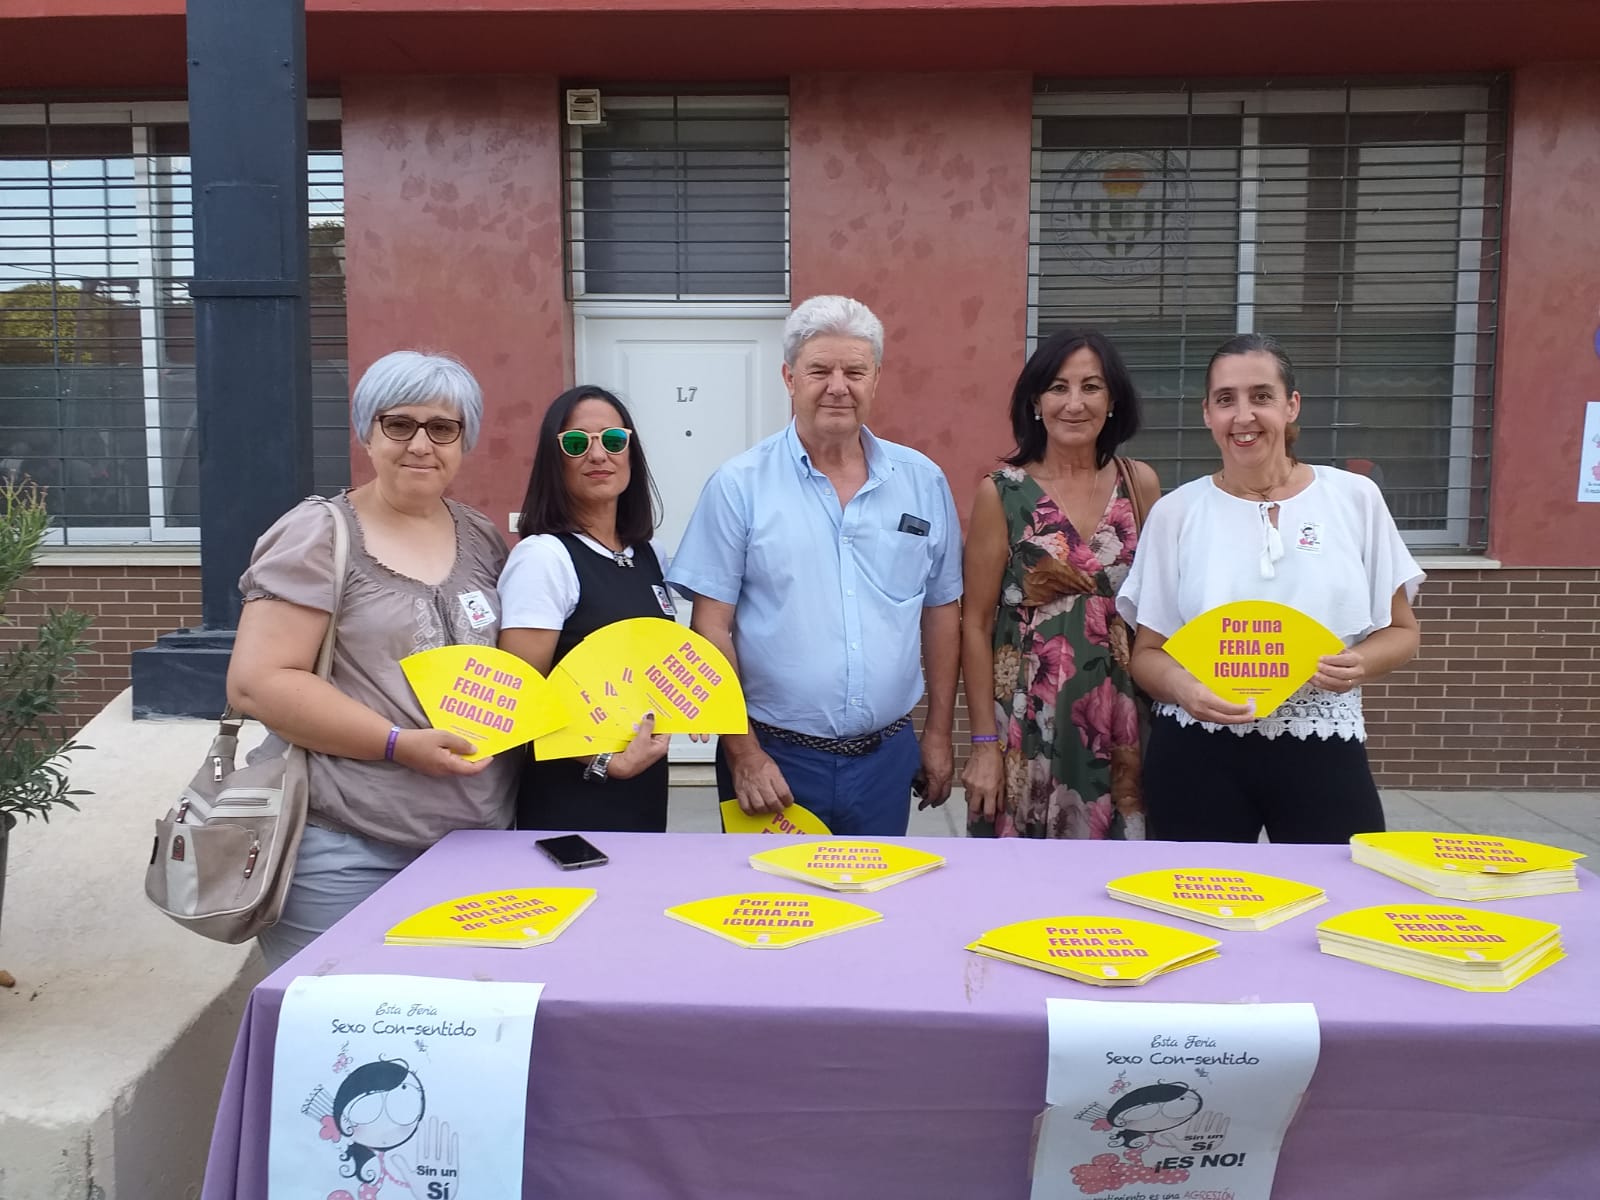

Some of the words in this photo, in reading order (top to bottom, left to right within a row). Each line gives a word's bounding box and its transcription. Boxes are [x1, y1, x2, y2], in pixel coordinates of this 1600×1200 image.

[676, 386, 698, 402] L7
[1222, 617, 1249, 633] Por
[1252, 619, 1282, 633] una
[1219, 640, 1261, 655] FERIA
[1264, 642, 1285, 655] en
[678, 641, 702, 666] Por
[697, 662, 723, 687] una
[1214, 662, 1290, 678] IGUALDAD
[464, 657, 492, 678] Por
[493, 670, 523, 690] una
[662, 654, 696, 689] FERIA
[692, 685, 711, 703] en
[453, 677, 495, 704] FERIA
[497, 695, 517, 711] en
[644, 665, 701, 720] IGUALDAD
[439, 695, 515, 734] IGUALDAD
[772, 812, 796, 834] Por
[1432, 837, 1464, 846] Por
[1469, 839, 1505, 847] una
[1435, 845, 1485, 854] FERIA
[1490, 847, 1514, 855] en
[1435, 852, 1528, 863] IGUALDAD
[1173, 874, 1205, 882] Por
[1209, 875, 1245, 883] una
[1175, 883, 1225, 892] FERIA
[1229, 884, 1254, 892] en
[454, 901, 482, 911] NO
[497, 894, 518, 902] la
[740, 898, 770, 906] Por
[1172, 891, 1265, 902] IGUALDAD
[449, 898, 544, 922] VIOLENCIA
[733, 908, 782, 916] FERIA
[787, 909, 810, 917] en
[1385, 912, 1422, 921] Por
[1425, 912, 1467, 921] una
[461, 922, 488, 931] de
[723, 918, 815, 927] IGUALDAD
[1393, 923, 1452, 932] FERIA
[1455, 924, 1485, 932] en
[1046, 927, 1081, 935] Por
[1084, 927, 1123, 935] una
[1048, 937, 1102, 946] FERIA
[1106, 938, 1135, 946] en
[1398, 934, 1508, 943] IGUALDAD
[1047, 948, 1149, 958] IGUALDAD
[375, 1002, 402, 1016] Esta
[407, 1002, 438, 1017] Feria
[331, 1018, 367, 1034] Sexo
[372, 1019, 477, 1037] Con-sentido
[1150, 1034, 1178, 1048] Esta
[1184, 1035, 1217, 1049] Feria
[1106, 1052, 1142, 1065] Sexo
[1149, 1052, 1260, 1066] Con-sentido
[1154, 1156, 1195, 1173] ¡ES
[1200, 1152, 1247, 1168] NO!
[416, 1165, 437, 1177] Sin
[440, 1167, 457, 1177] un
[427, 1182, 450, 1200] Sí
